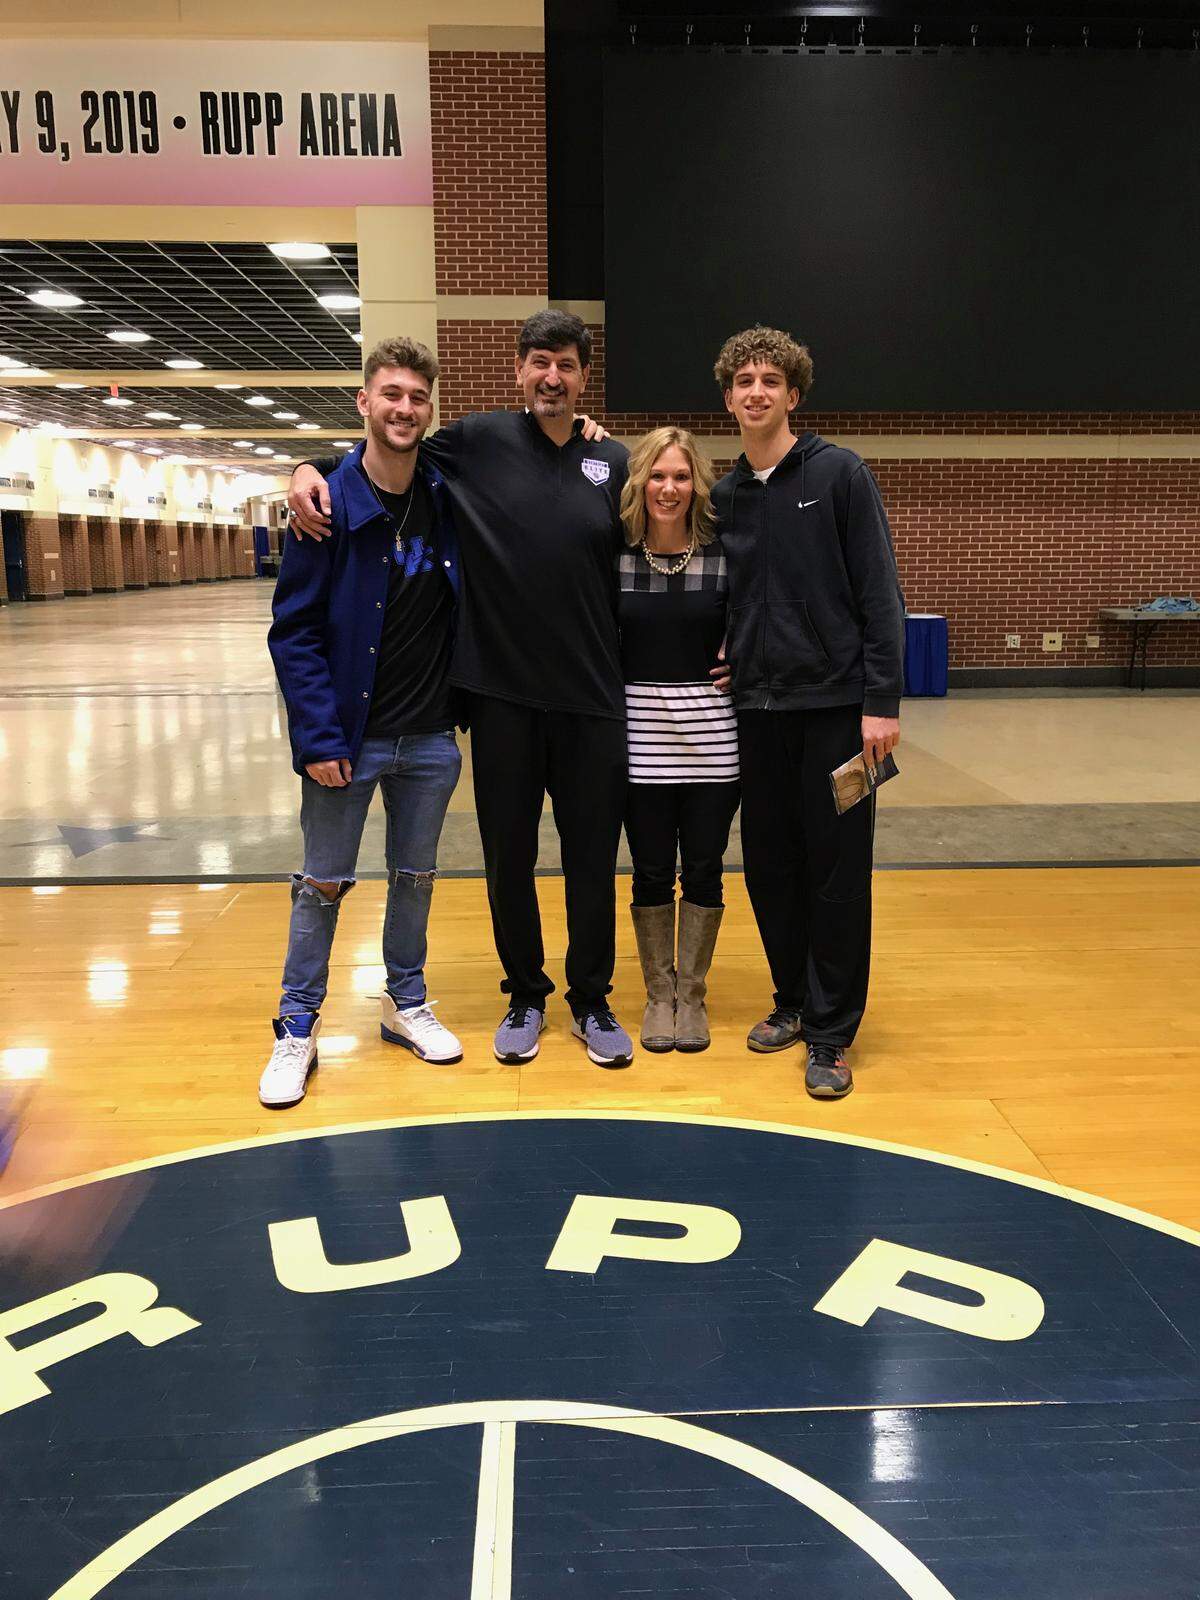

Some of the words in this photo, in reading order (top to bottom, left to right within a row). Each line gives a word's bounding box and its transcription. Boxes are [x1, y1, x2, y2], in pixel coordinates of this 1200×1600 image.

[0, 90, 20, 153] Y
[35, 90, 70, 162] 9,
[80, 90, 160, 154] 2019
[199, 91, 284, 156] RUPP
[299, 92, 402, 157] ARENA
[0, 1194, 1045, 1415] RUPP
